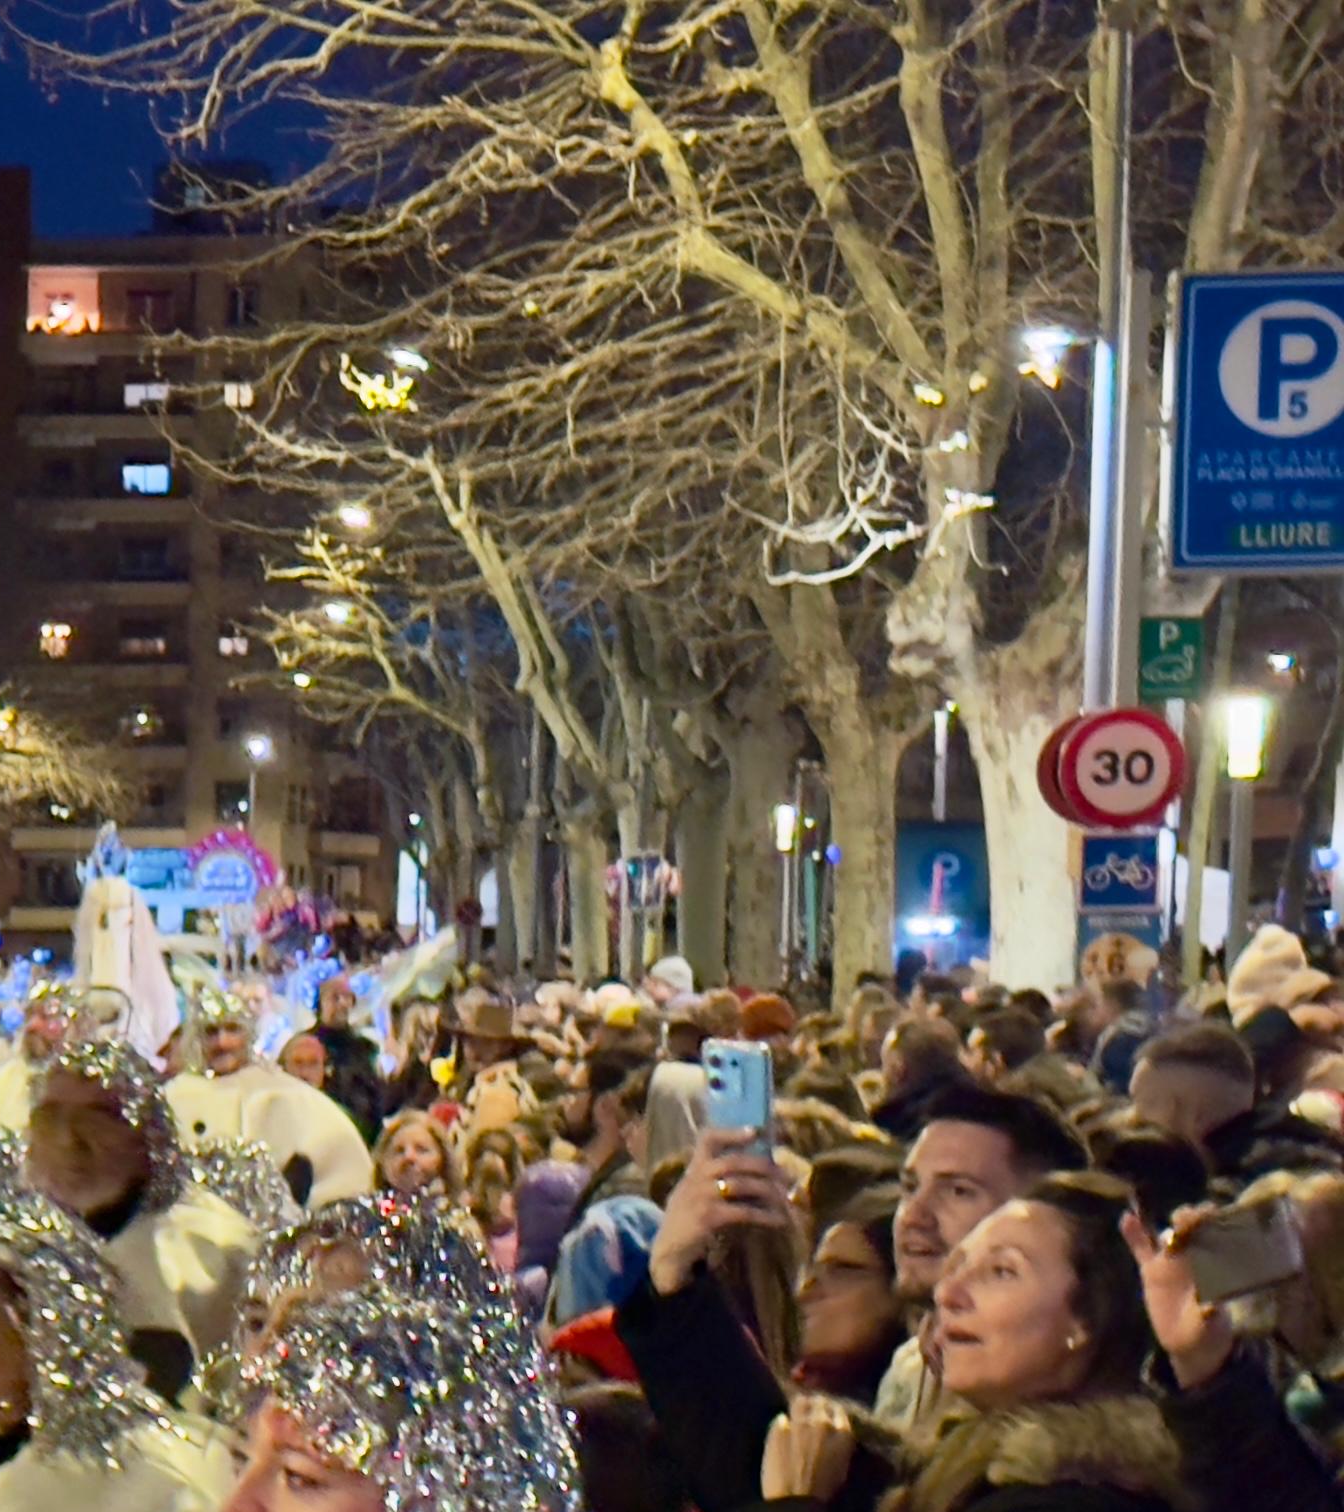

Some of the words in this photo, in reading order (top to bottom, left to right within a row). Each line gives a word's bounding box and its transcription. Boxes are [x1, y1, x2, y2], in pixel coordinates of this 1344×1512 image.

[1258, 317, 1339, 420] P
[1287, 391, 1308, 419] 5
[1239, 521, 1330, 547] LLIURE
[1159, 622, 1180, 649] P
[1092, 749, 1155, 785] 30
